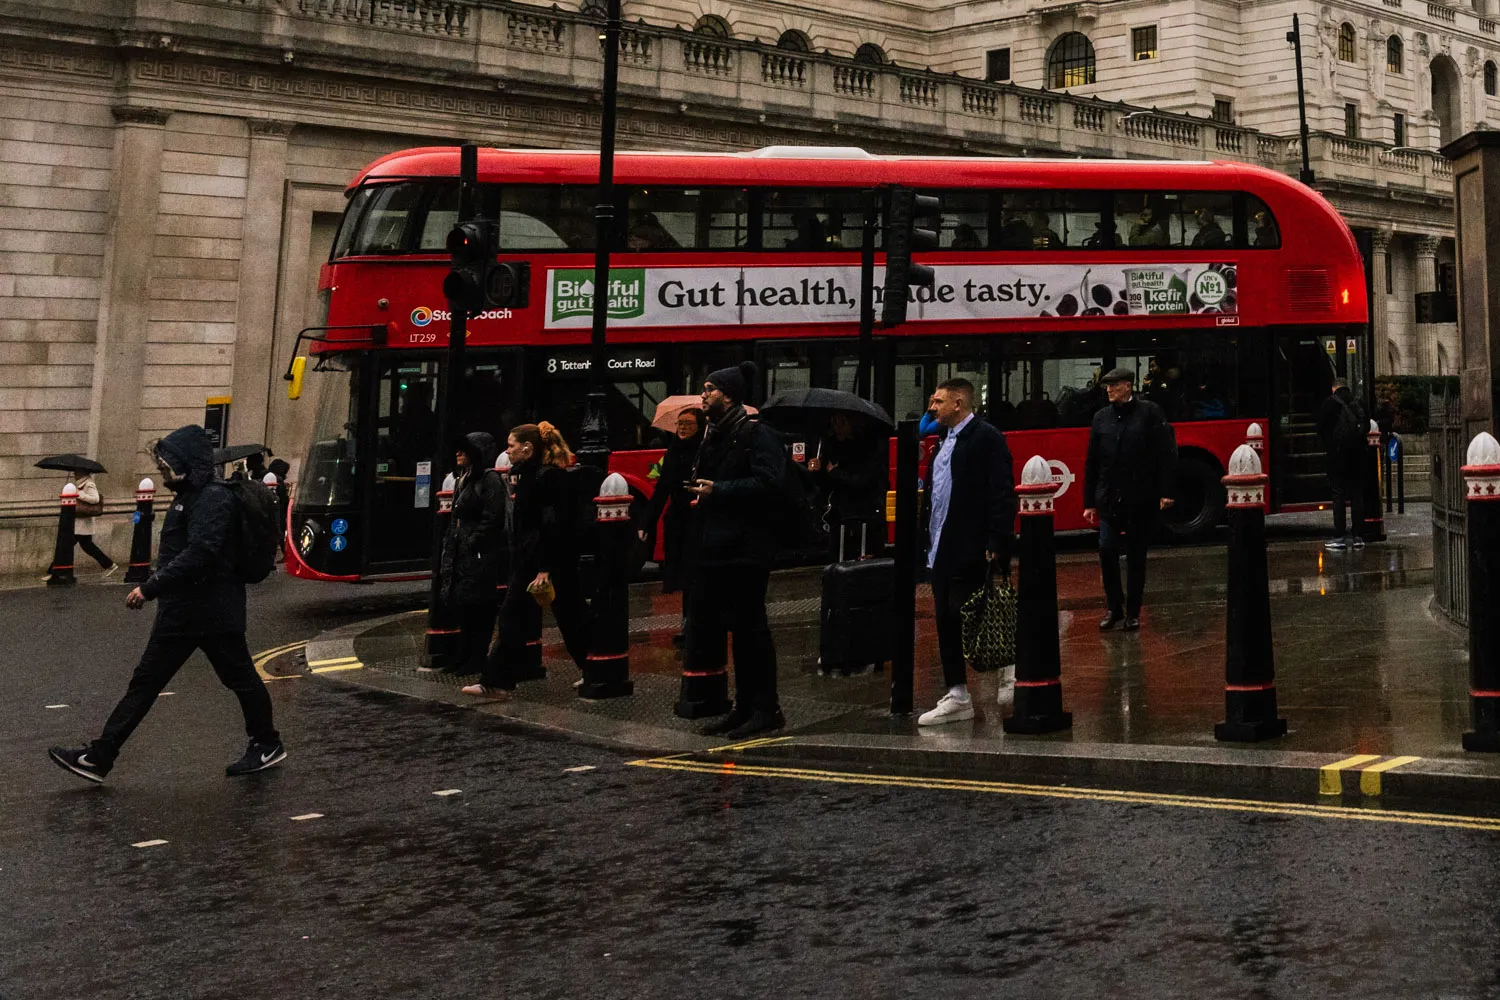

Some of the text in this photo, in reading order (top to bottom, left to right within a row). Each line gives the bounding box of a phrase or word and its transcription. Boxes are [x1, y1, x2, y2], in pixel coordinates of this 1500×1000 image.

[557, 279, 639, 298] Bioiful
[658, 281, 726, 308] Gut
[735, 278, 856, 309] health,
[963, 278, 1051, 307] tasty.
[1149, 289, 1183, 302] kefir
[556, 297, 639, 312] gut halth
[1146, 302, 1184, 312] protein
[432, 307, 512, 321] Staoach
[410, 333, 437, 343] LT259
[547, 358, 656, 374] 8 Tottenh Court Road
